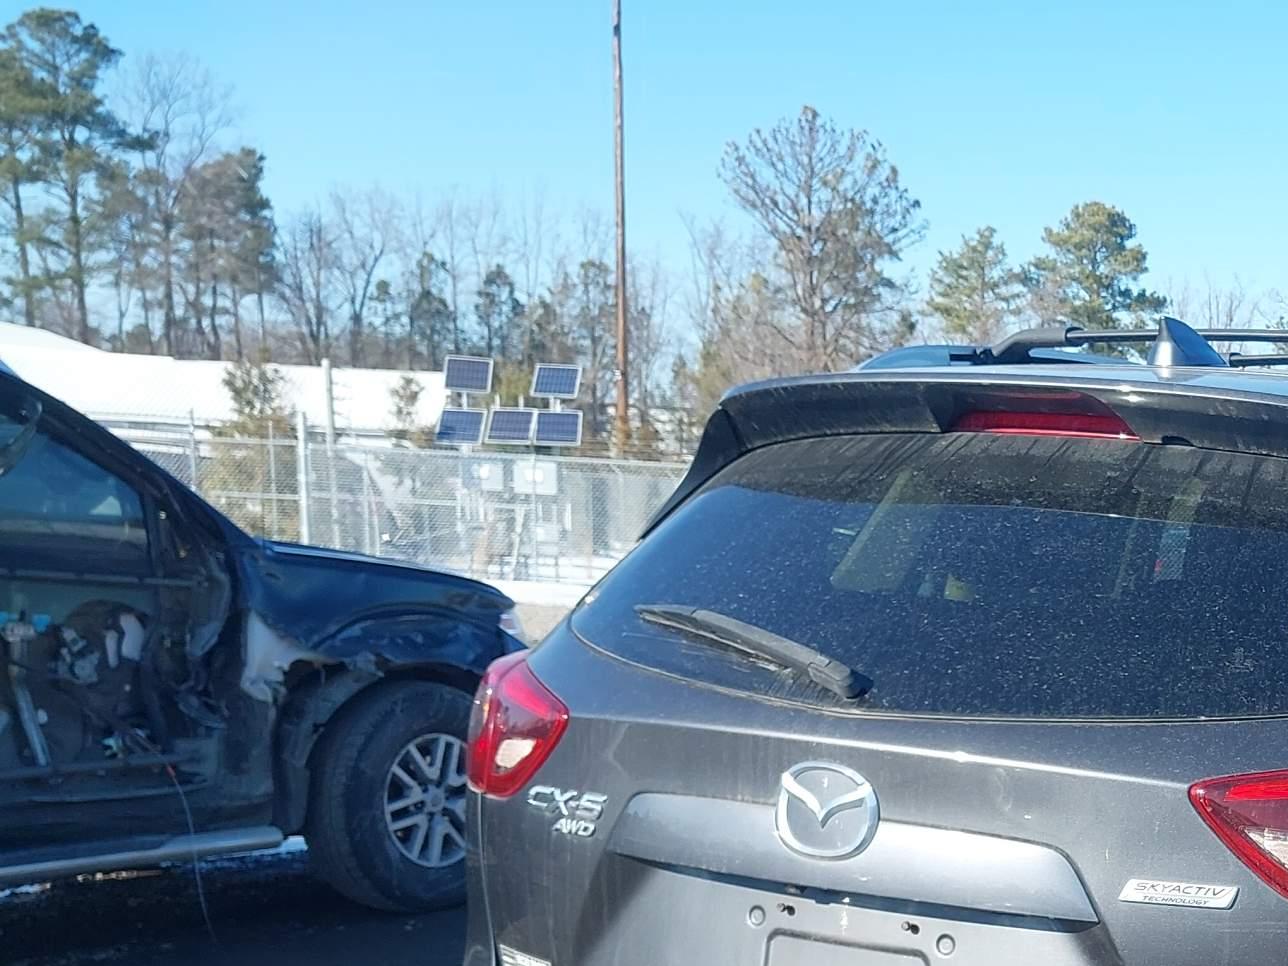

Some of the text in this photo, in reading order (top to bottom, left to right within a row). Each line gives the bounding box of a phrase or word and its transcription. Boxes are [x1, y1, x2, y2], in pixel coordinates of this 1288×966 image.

[528, 785, 608, 820] CX-5
[552, 818, 596, 837] AWD
[1135, 882, 1226, 897] SKYACTIV
[1142, 895, 1209, 906] TECHNOLOGY
